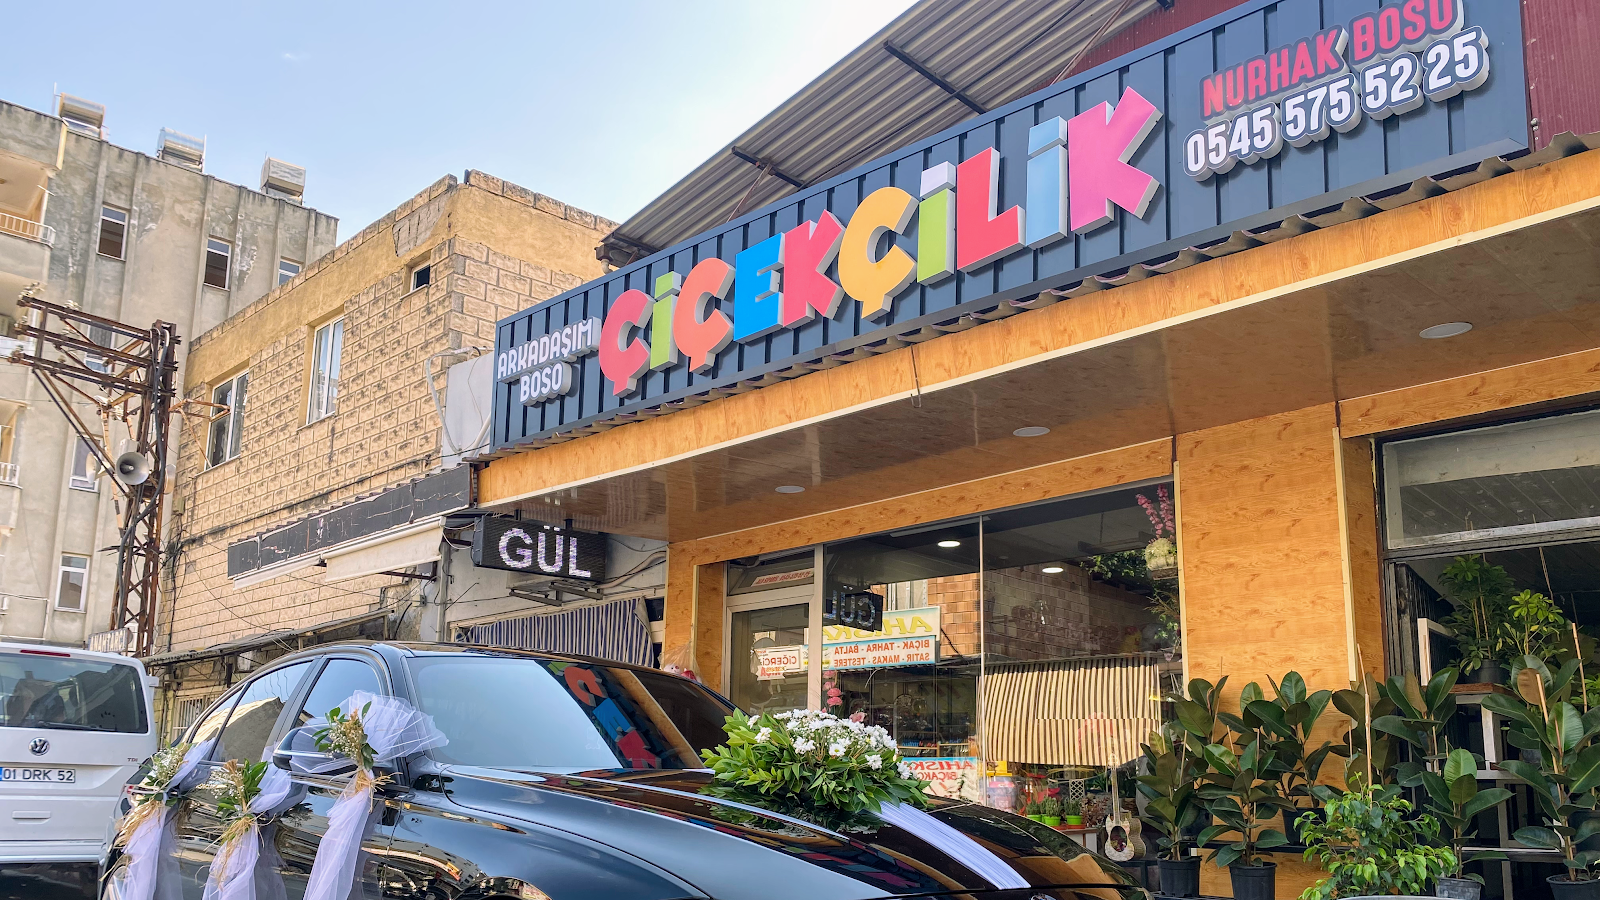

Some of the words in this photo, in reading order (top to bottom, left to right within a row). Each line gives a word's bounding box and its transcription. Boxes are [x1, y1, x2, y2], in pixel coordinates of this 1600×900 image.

[1186, 106, 1274, 173] 0545
[1285, 77, 1352, 139] 575
[1365, 57, 1414, 109] 52
[1426, 30, 1479, 90] 25
[1202, 29, 1339, 117] NURHAK
[497, 318, 593, 380] ARKADAŞIM
[520, 362, 563, 402] BOSO
[498, 525, 591, 578] GÜL
[3, 769, 17, 780] 01
[22, 769, 52, 780] DRK
[57, 770, 74, 781] 52
